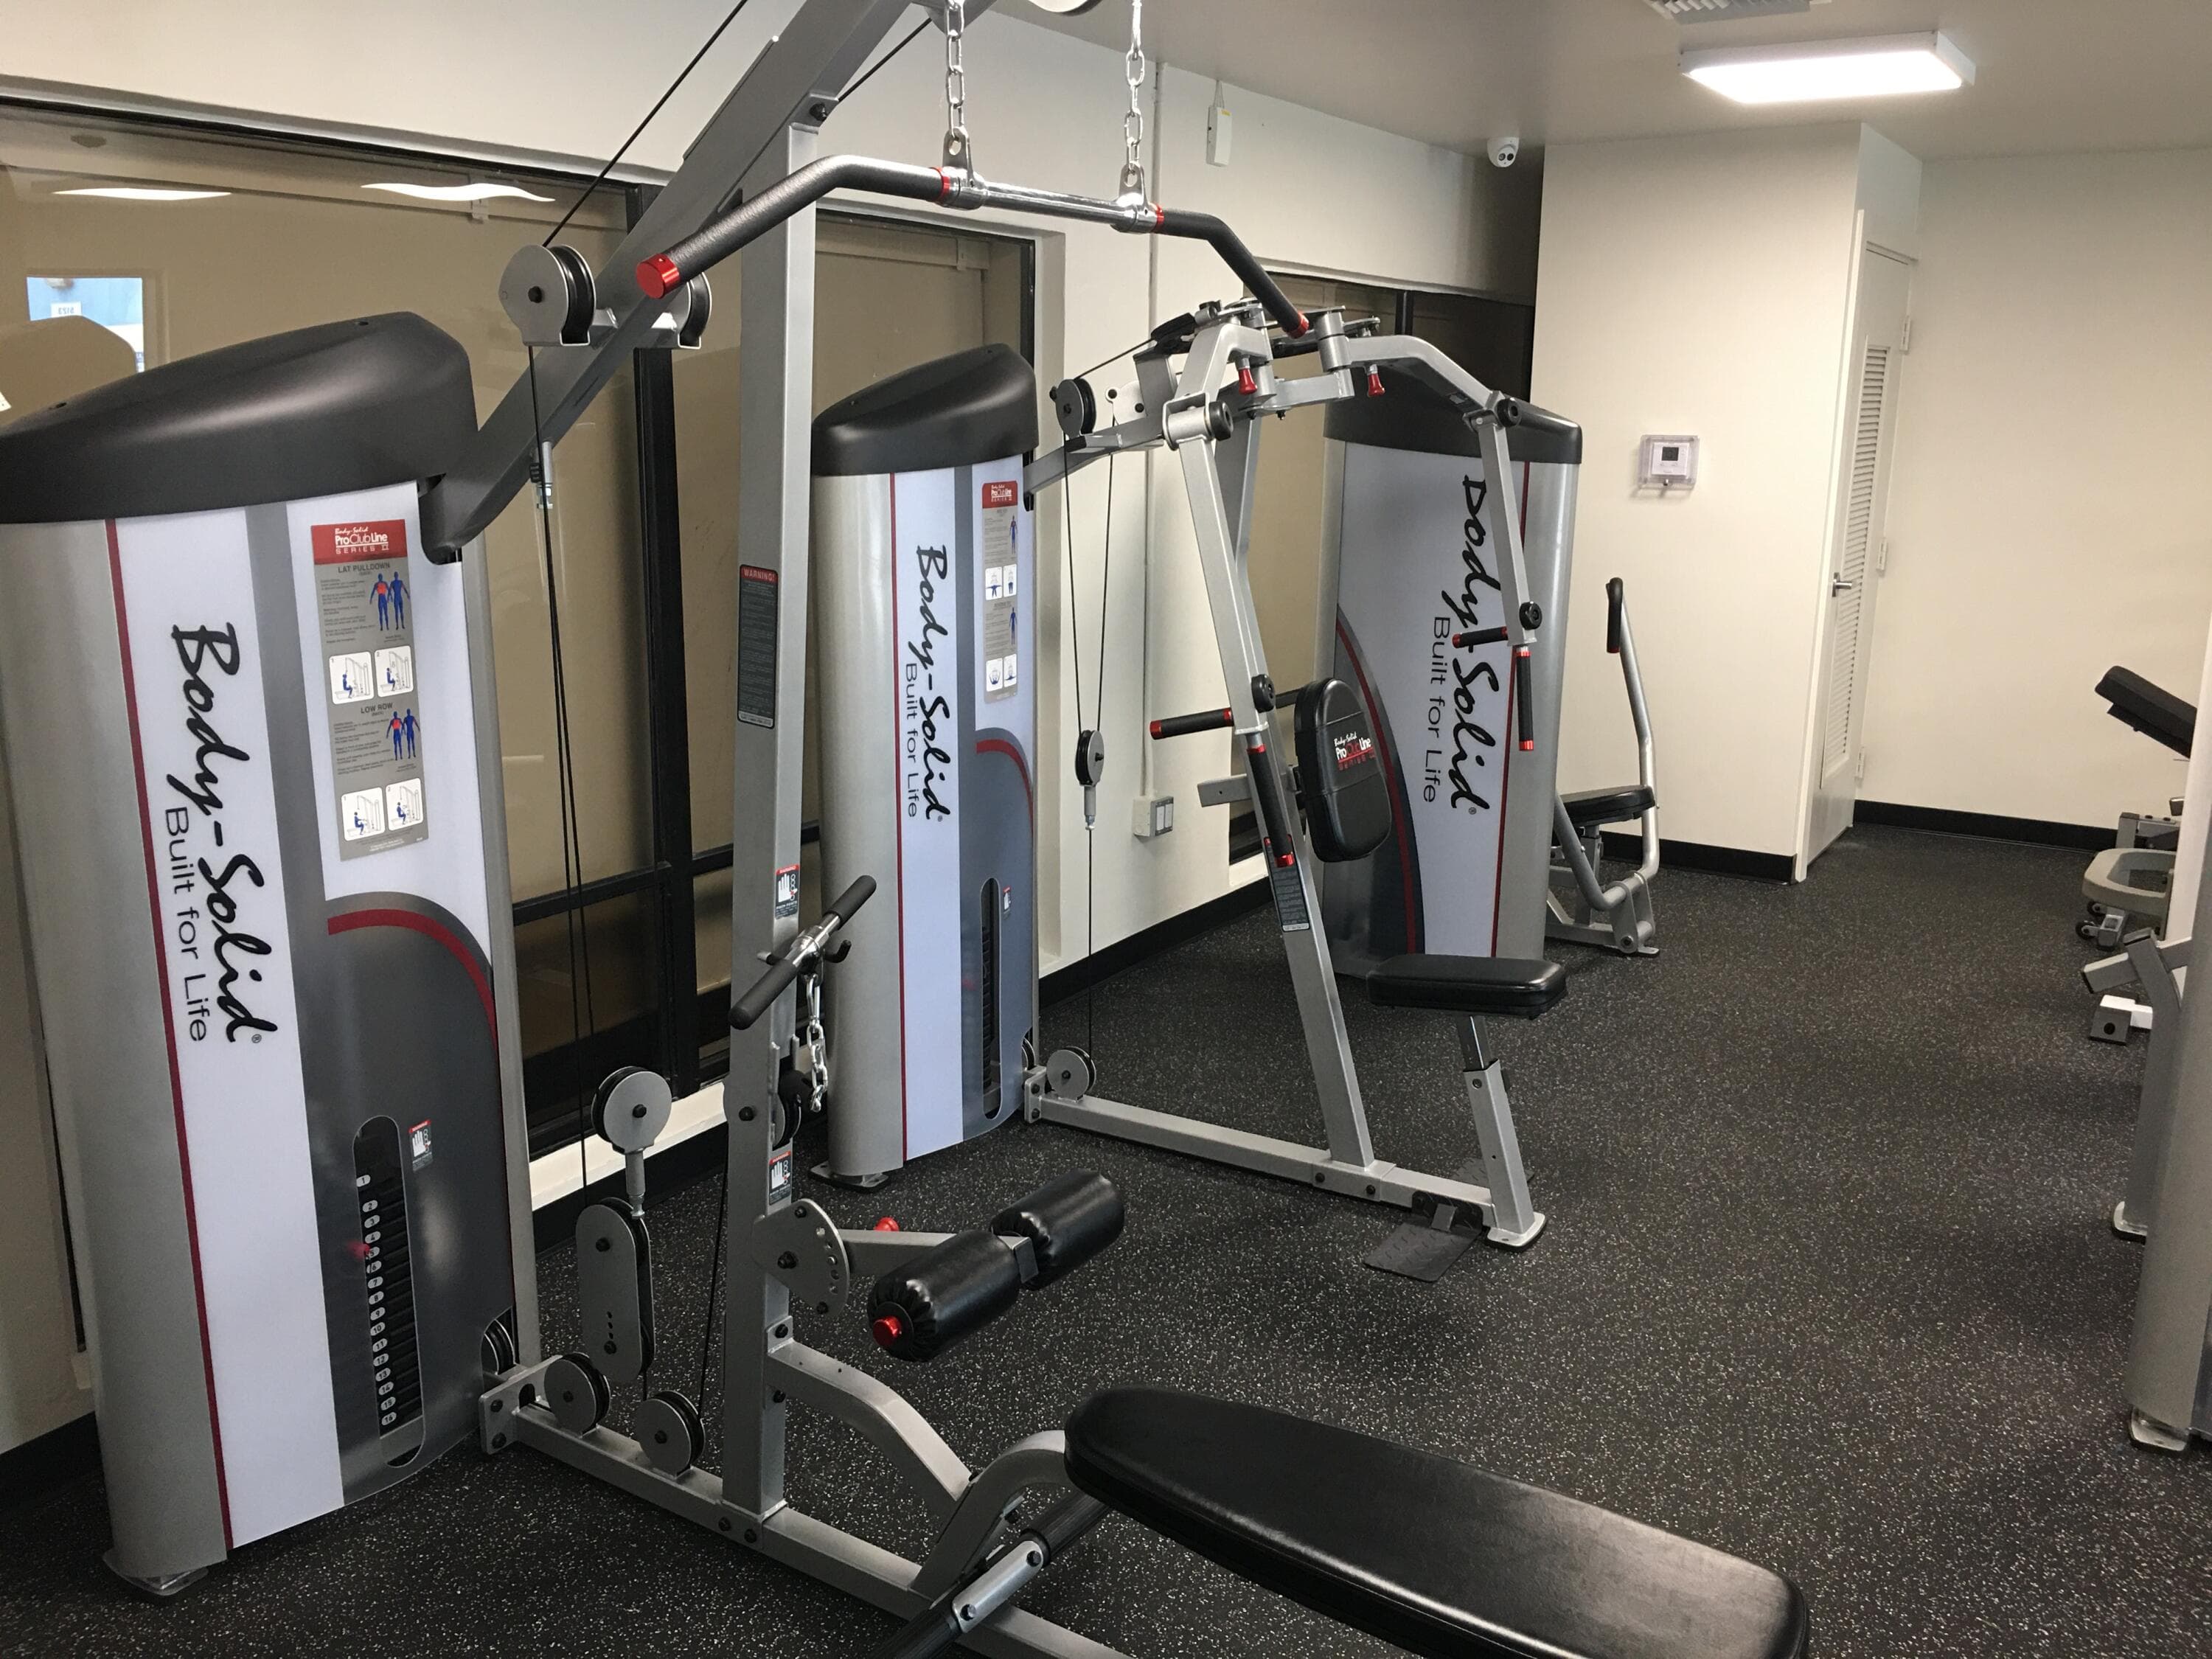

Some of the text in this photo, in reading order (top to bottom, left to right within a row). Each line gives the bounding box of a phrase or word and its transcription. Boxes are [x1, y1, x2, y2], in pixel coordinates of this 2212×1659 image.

[335, 532, 389, 546] ProClubLine
[335, 545, 375, 554] SERIES
[338, 565, 352, 574] LAT
[353, 560, 391, 572] PULLDOWN
[908, 544, 951, 821] Body-Solid
[361, 702, 393, 714] LOW ROW
[1423, 616, 1451, 804] Built for Life
[905, 663, 919, 818] Built for Life
[167, 622, 278, 1044] Body-Solid
[164, 807, 210, 1043] Built for Life
[373, 1325, 382, 1334] 10
[376, 1340, 384, 1350] 11
[377, 1355, 385, 1364] 12
[379, 1370, 387, 1380] 13
[382, 1384, 391, 1393] 14
[384, 1399, 392, 1408] 15
[385, 1415, 394, 1423] 16
